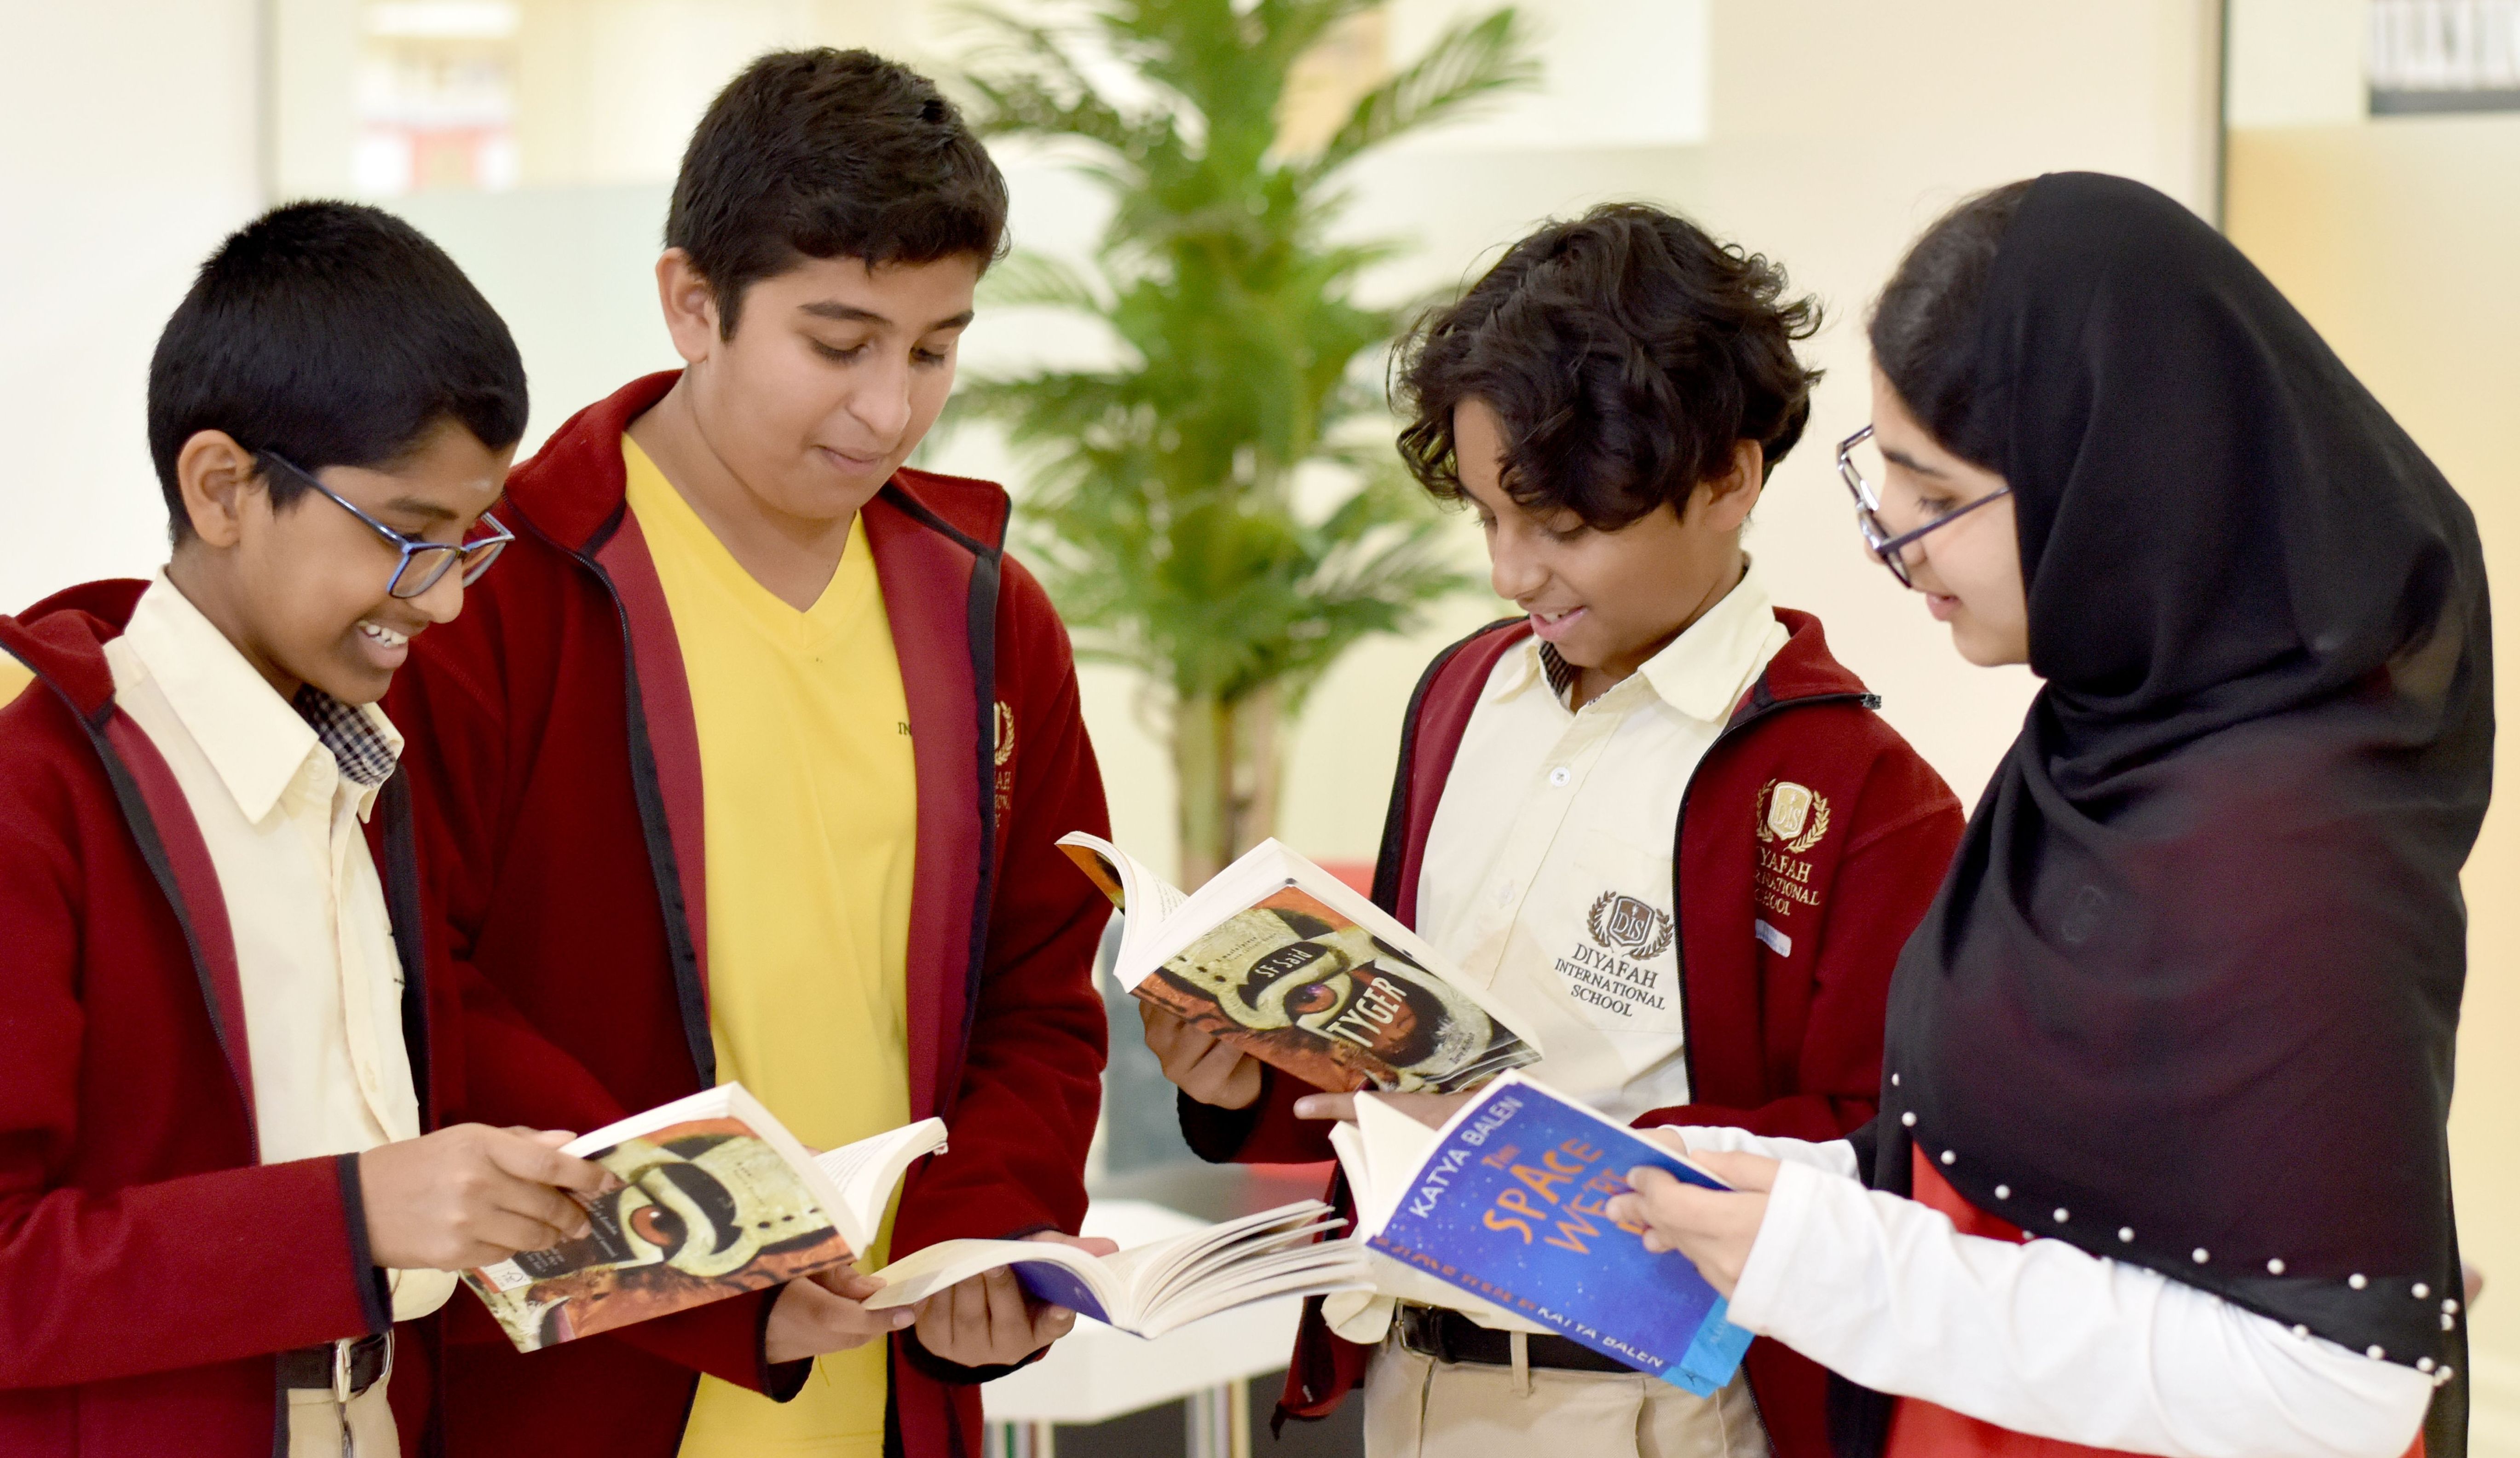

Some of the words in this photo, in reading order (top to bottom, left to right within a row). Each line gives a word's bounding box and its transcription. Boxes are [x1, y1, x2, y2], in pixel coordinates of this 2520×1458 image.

[1757, 847, 1813, 883] YAFAH
[1754, 888, 1791, 916] CHOOL
[1612, 911, 1645, 940] DIS
[1255, 964, 1280, 978] SF
[1272, 948, 1313, 968] Said
[1572, 943, 1658, 989] DIYAFAH
[1554, 958, 1665, 1010] INTERNATIONAL
[1570, 984, 1633, 1017] SCHOOL
[1326, 977, 1407, 1048] TYGER
[1408, 1146, 1471, 1219] KATYA
[1460, 1095, 1524, 1147] BALEN
[1483, 1138, 1604, 1245] SPACE
[1602, 1336, 1664, 1368] BALEN
